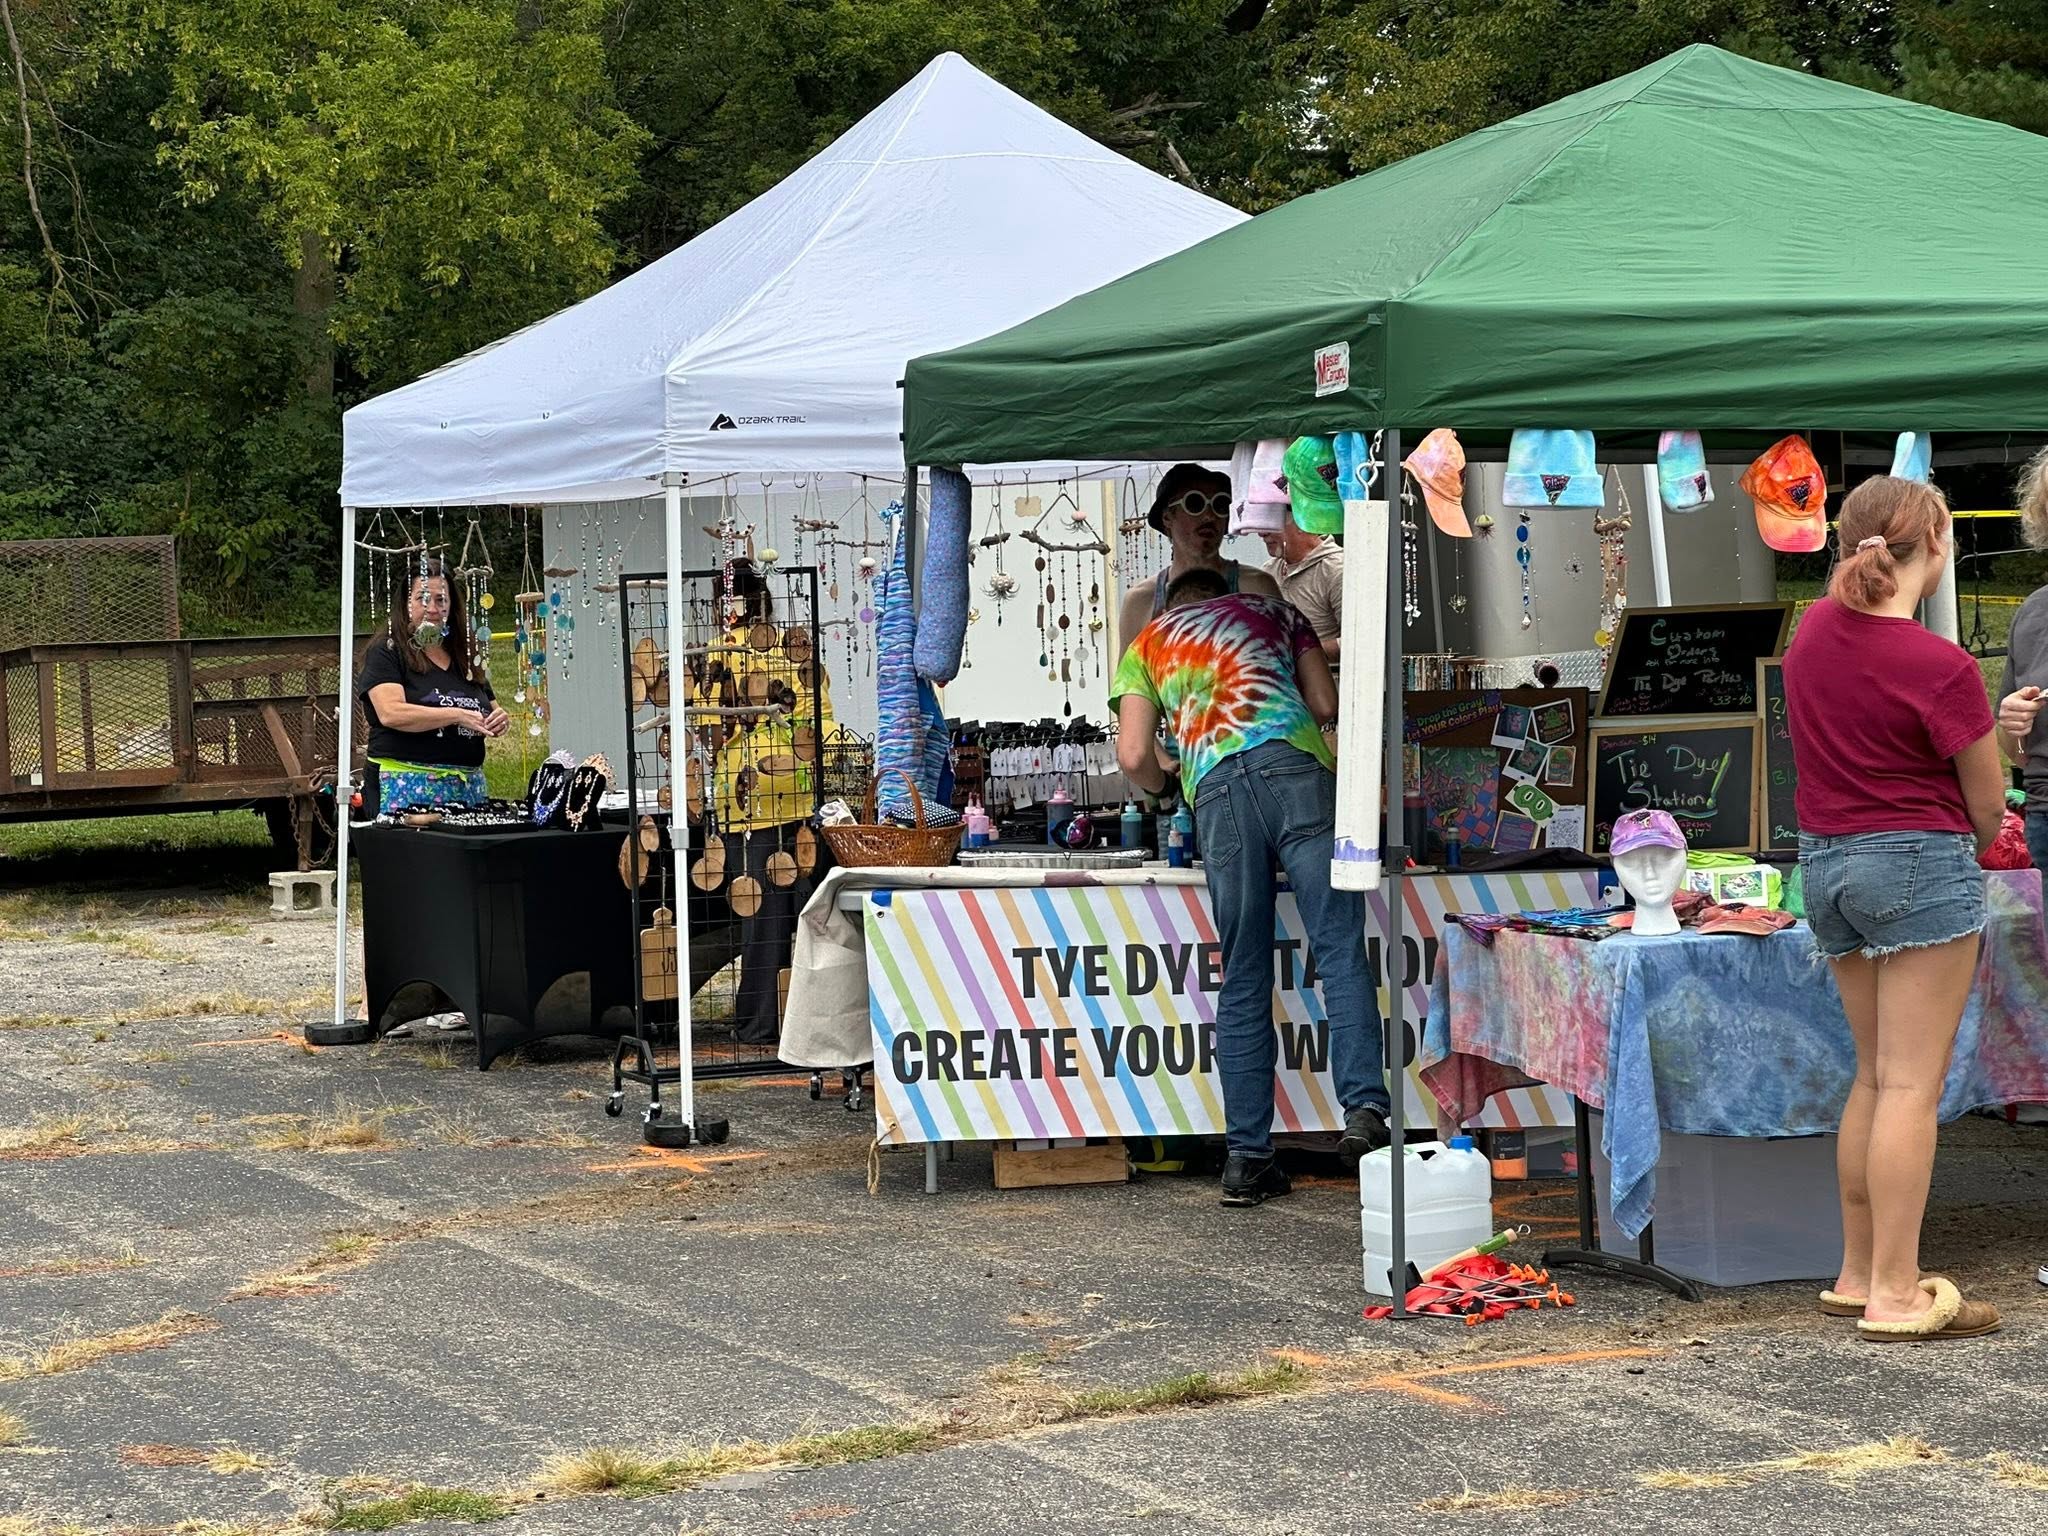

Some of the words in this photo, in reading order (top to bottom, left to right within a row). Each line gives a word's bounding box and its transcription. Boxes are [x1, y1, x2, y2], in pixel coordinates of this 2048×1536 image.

[738, 416, 774, 425] OZARK
[776, 415, 806, 424] TRAIL
[1650, 619, 1726, 646] Custom
[1667, 643, 1717, 660] Orders
[1661, 672, 1687, 693] Dye
[438, 695, 454, 707] 25
[1416, 713, 1441, 727] Drop
[1442, 706, 1458, 718] the
[1459, 696, 1486, 712] Gray!
[1407, 730, 1421, 741] Let
[1422, 720, 1448, 736] YOUR
[1448, 710, 1477, 727] Colors
[1606, 749, 1651, 784] Tie
[1012, 945, 1109, 998] TYE
[1124, 942, 1222, 996] DYE
[892, 1027, 1079, 1084] CREATE
